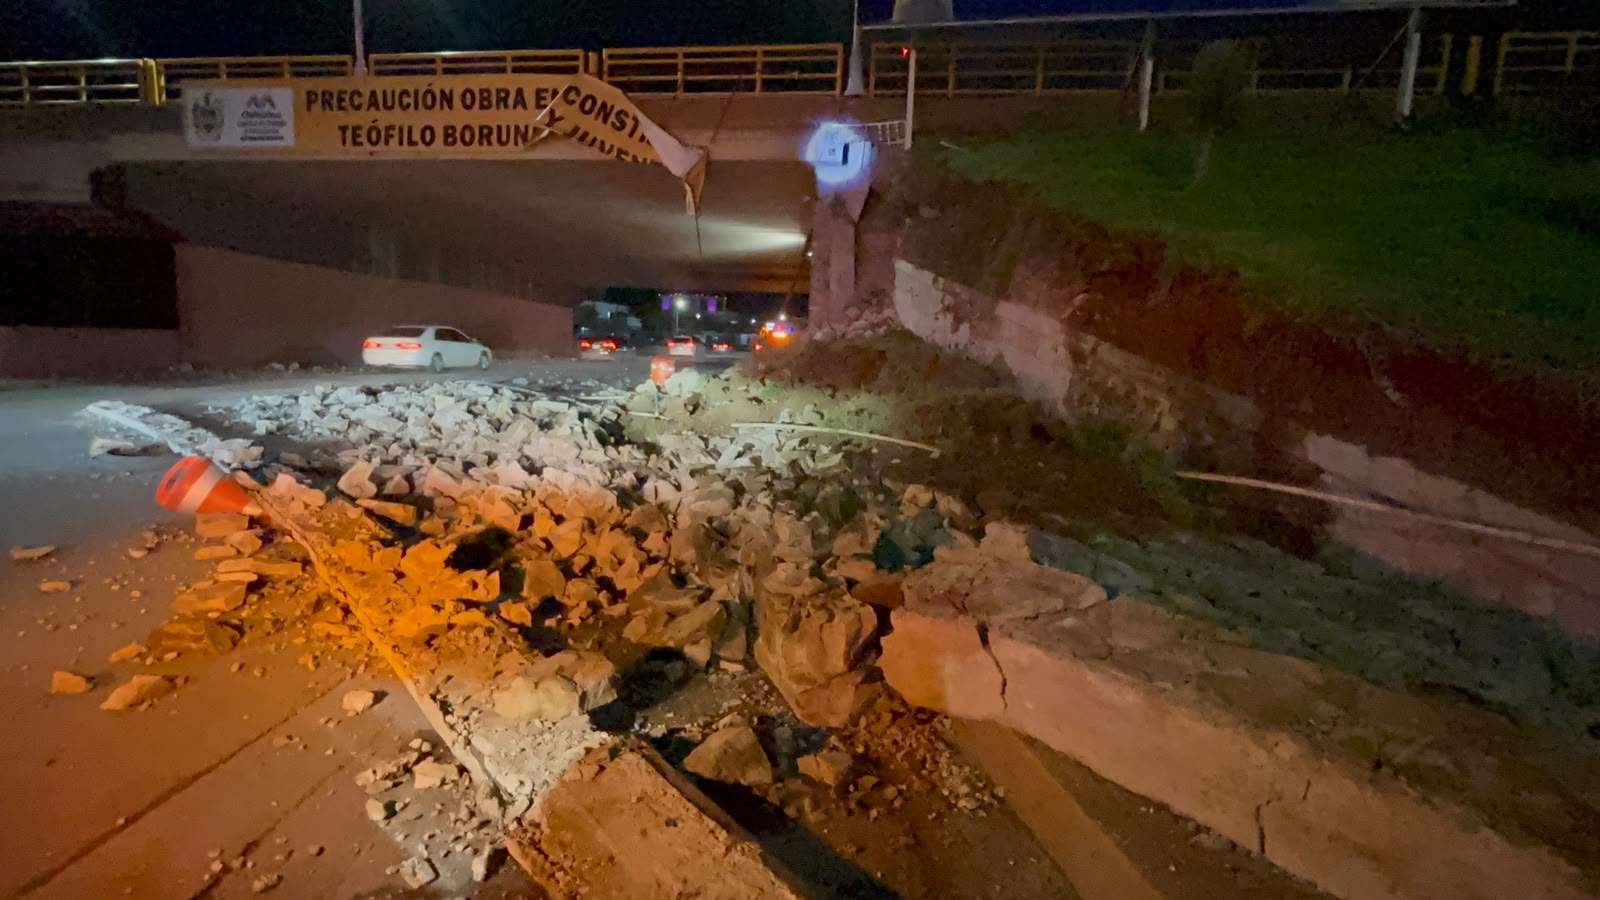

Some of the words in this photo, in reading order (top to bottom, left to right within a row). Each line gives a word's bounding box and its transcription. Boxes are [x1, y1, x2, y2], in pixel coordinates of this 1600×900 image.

[305, 82, 454, 113] PRECAUCIÓN
[460, 87, 528, 112] OBRA
[338, 119, 436, 148] TEÓFILO
[544, 108, 565, 128] Y
